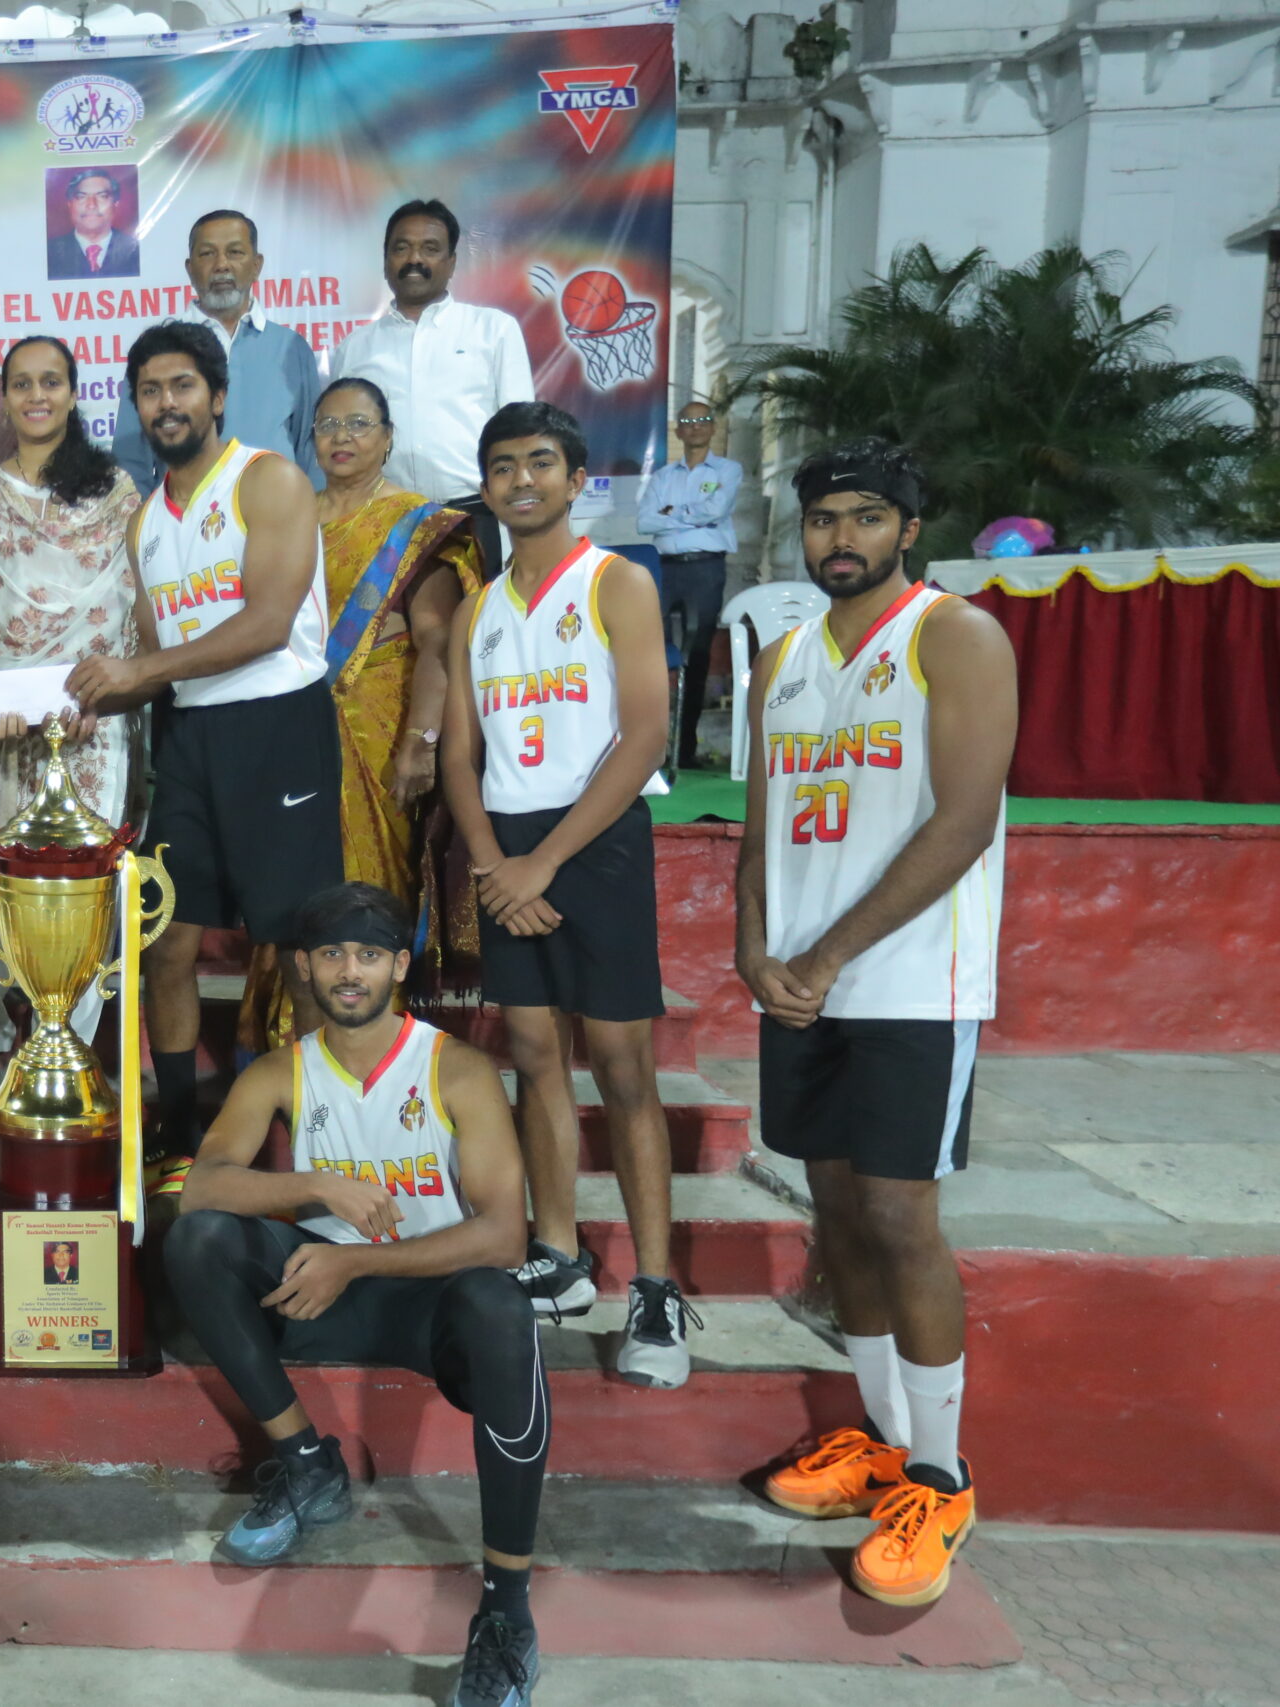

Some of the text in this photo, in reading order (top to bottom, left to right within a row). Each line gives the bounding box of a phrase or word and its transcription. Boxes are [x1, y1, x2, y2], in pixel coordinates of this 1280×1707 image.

[550, 88, 629, 109] YMCA
[58, 134, 124, 151] SWAT
[149, 559, 246, 621] ITANS
[477, 663, 588, 718] TITANS
[518, 714, 544, 768] 3
[768, 720, 903, 779] TITANS
[791, 779, 850, 845] 20
[27, 1315, 99, 1328] WINNERS
